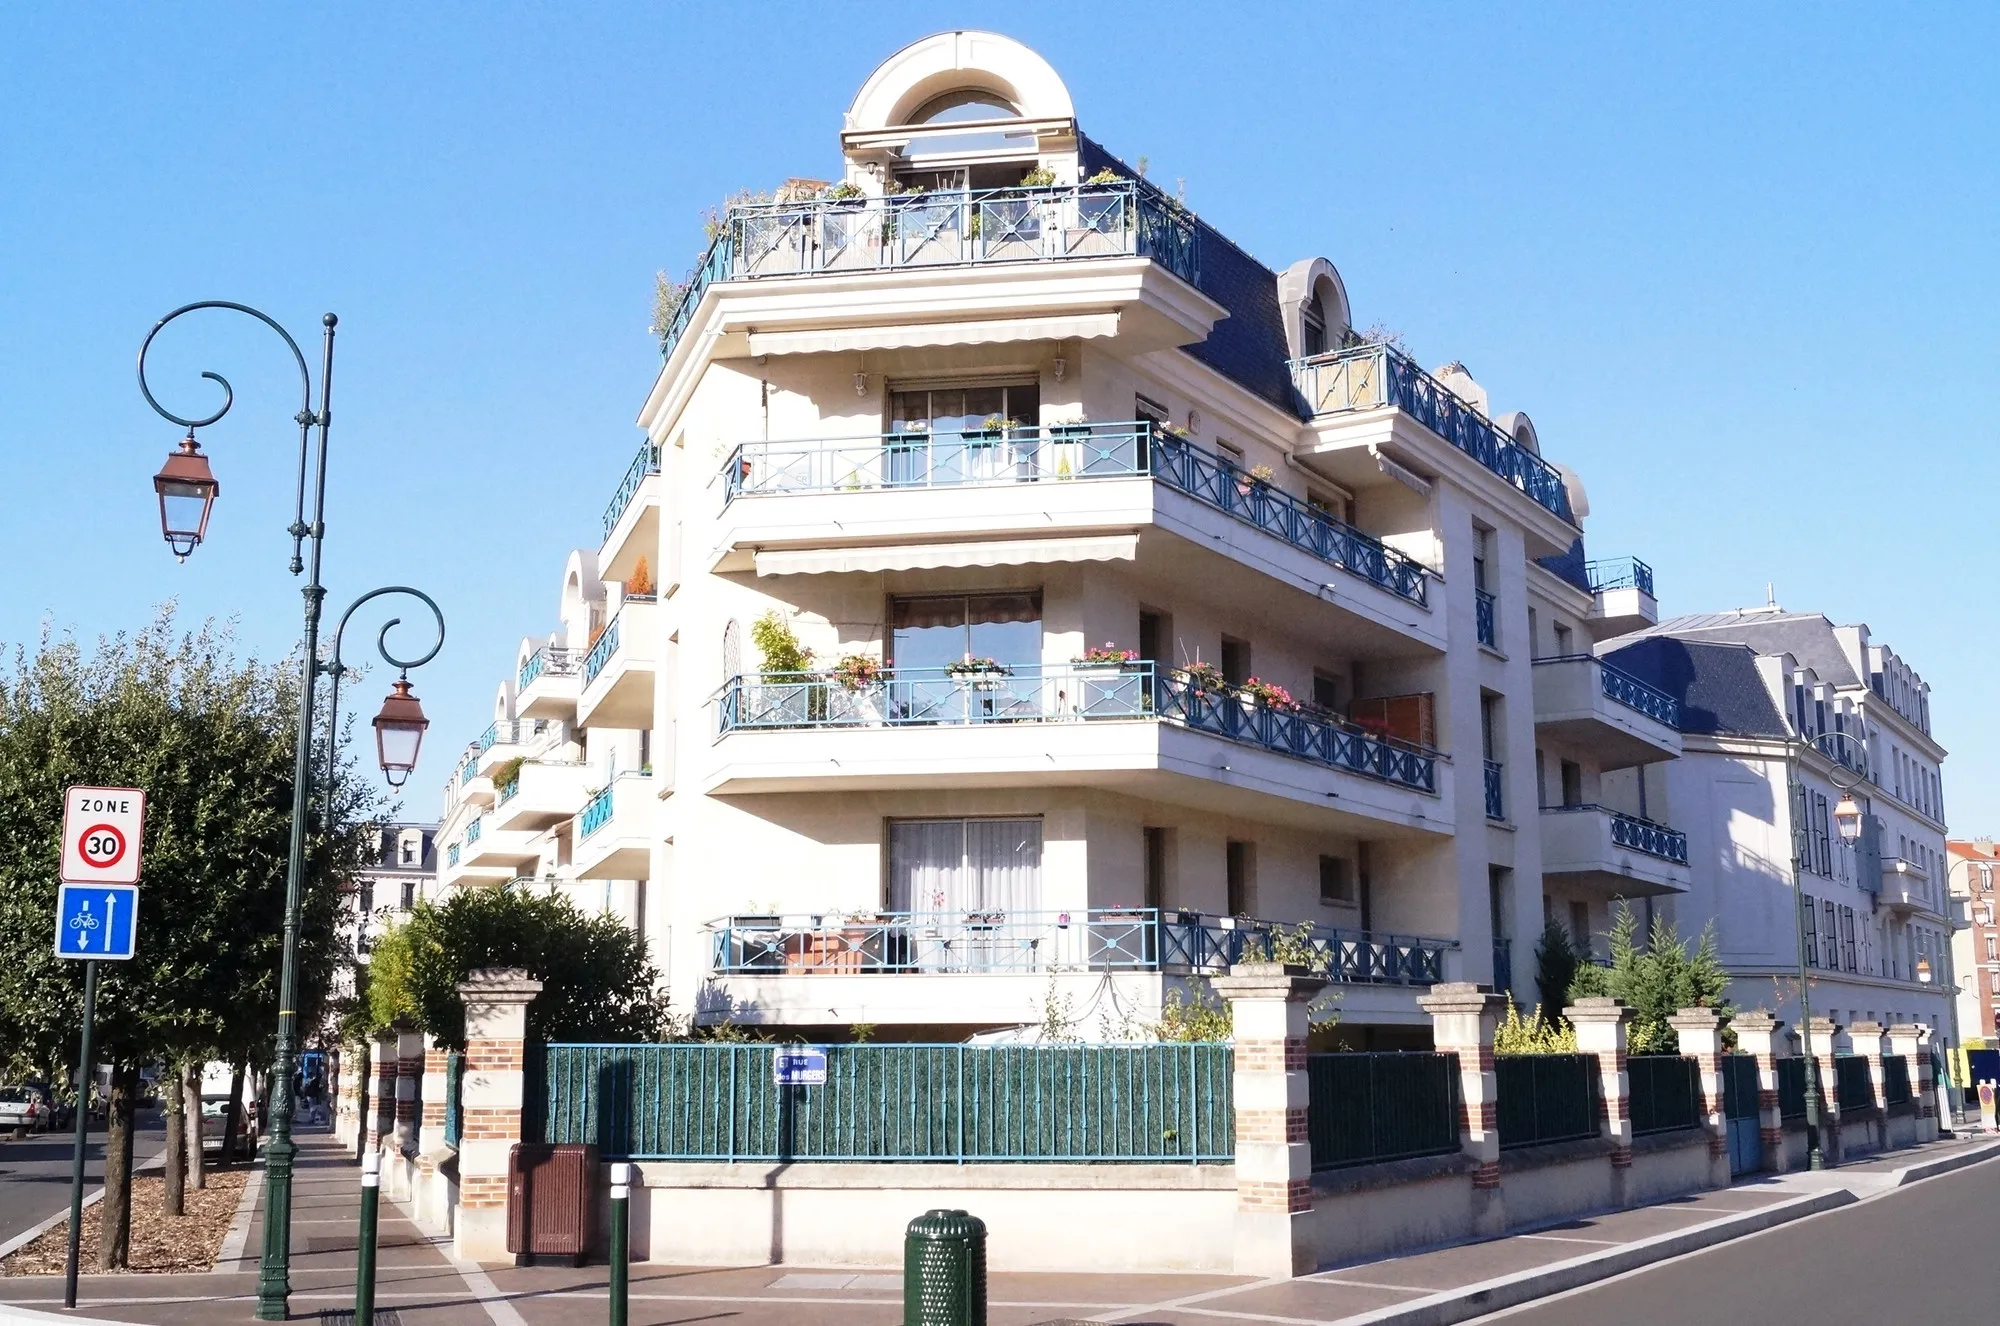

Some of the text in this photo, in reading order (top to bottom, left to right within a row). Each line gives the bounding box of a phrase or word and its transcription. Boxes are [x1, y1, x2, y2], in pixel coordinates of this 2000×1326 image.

[81, 799, 129, 813] ZONE
[88, 837, 116, 855] 30
[792, 1058, 808, 1066] RUE
[791, 1069, 825, 1081] MURGERS
